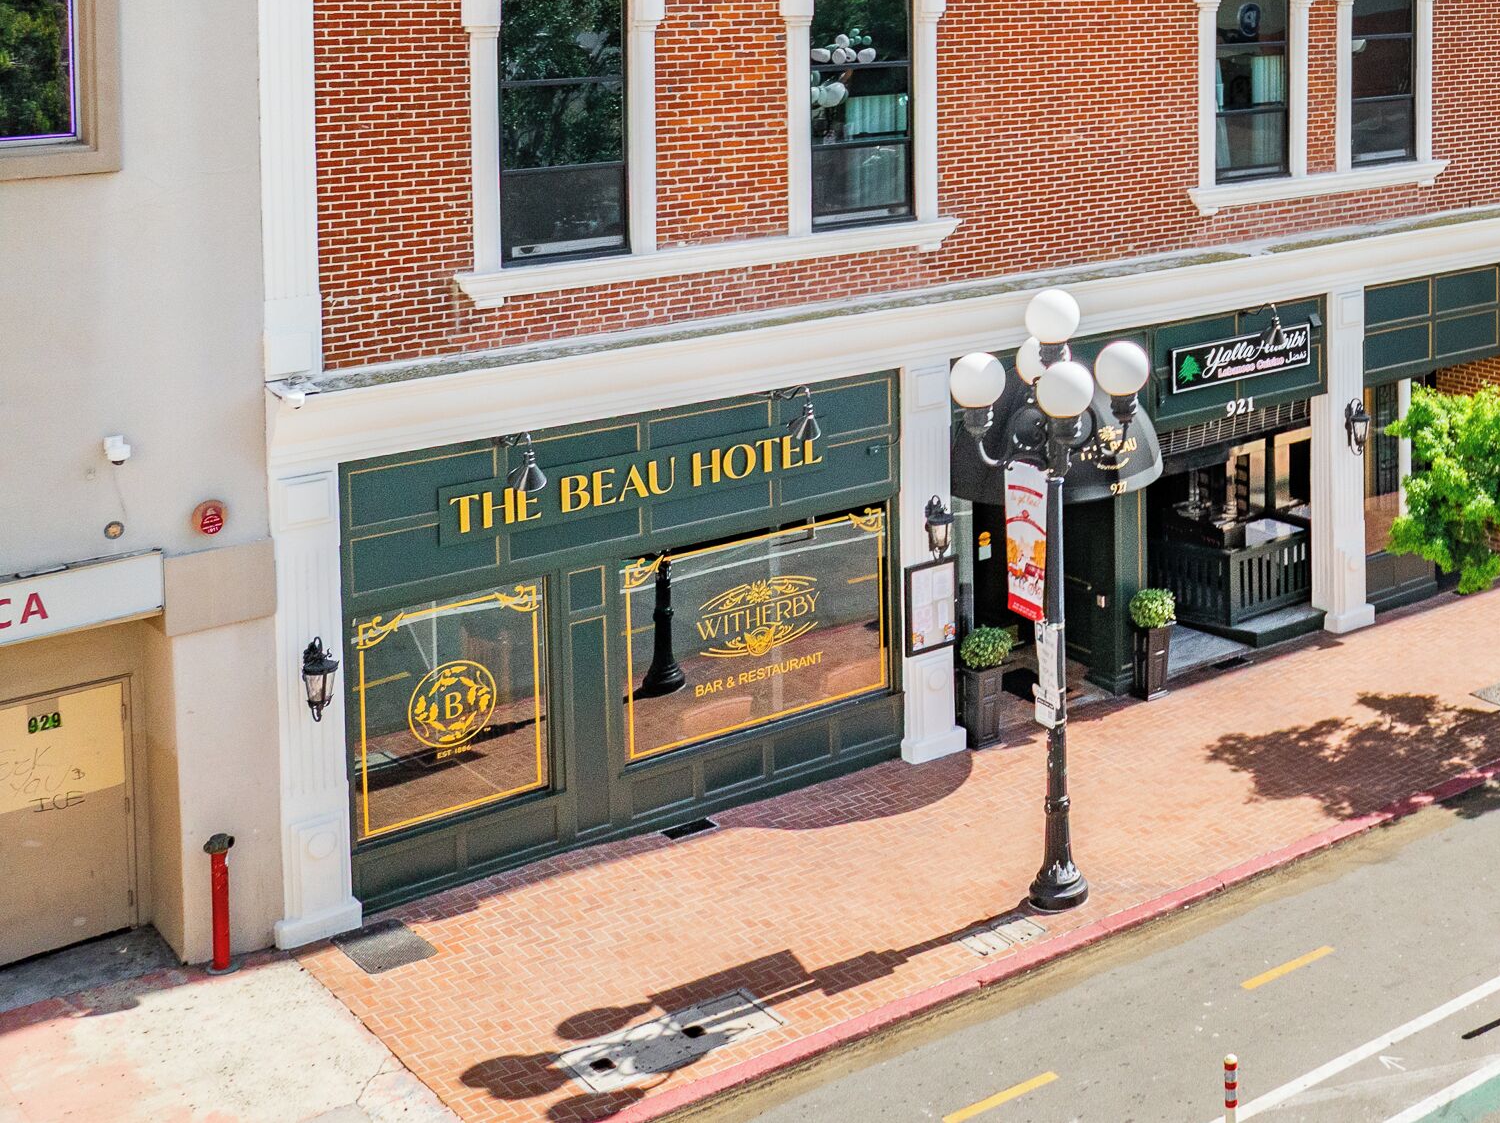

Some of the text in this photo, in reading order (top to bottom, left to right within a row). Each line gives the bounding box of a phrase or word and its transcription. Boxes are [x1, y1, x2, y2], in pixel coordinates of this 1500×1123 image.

[1202, 341, 1255, 378] Yalla
[1226, 396, 1255, 417] 921
[449, 433, 823, 533] THE BEAU HOTEL
[1110, 481, 1128, 495] 927
[696, 591, 820, 640] WITHERBY
[695, 651, 824, 697] BAR & RESTAURANT
[444, 691, 464, 720] B
[437, 749, 452, 759] EST
[29, 790, 86, 813] ICE
